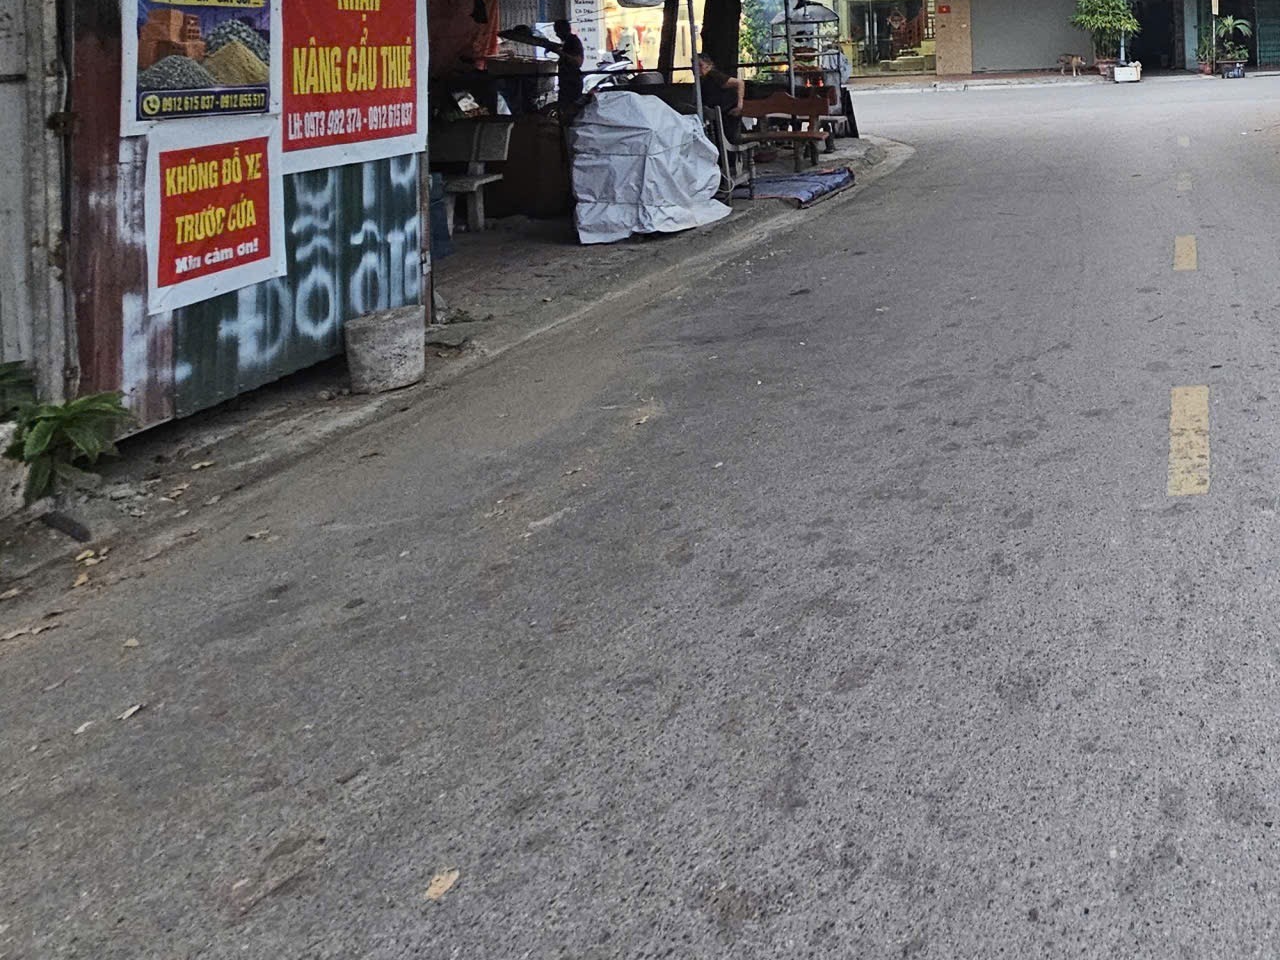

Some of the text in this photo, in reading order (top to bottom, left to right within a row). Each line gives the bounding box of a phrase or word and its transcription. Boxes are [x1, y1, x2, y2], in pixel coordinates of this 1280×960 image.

[293, 27, 412, 95] NÂNG CẨU THUÊ
[288, 112, 303, 140] LH:
[304, 111, 326, 138] 0973
[327, 108, 346, 135] 982
[346, 107, 362, 133] 374
[368, 104, 387, 130] 0912
[165, 157, 219, 197] KHÔNG
[222, 147, 242, 186] ĐỖ
[245, 152, 263, 180] XE
[175, 203, 226, 245] TRƯỚC
[175, 255, 201, 274] Xin
